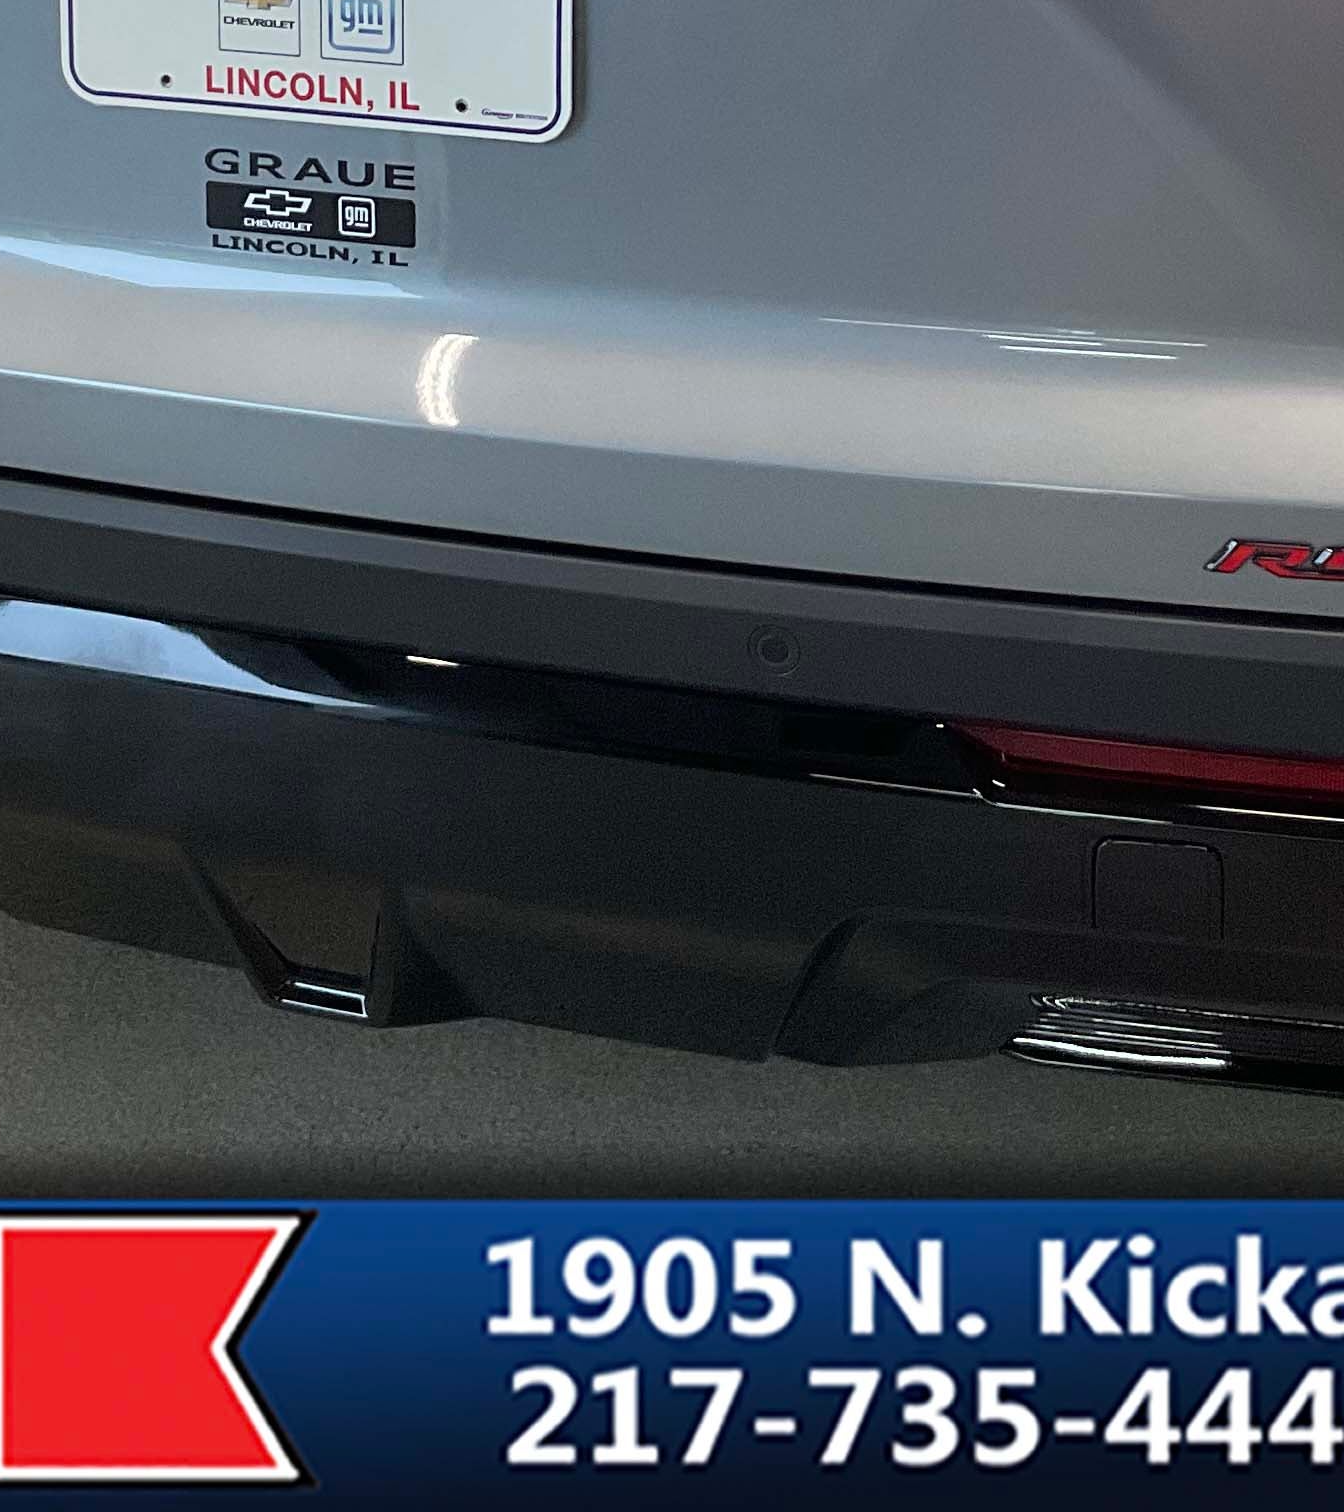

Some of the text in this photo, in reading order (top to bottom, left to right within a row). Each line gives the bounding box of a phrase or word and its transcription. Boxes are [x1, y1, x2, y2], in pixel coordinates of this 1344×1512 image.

[223, 15, 296, 31] CHEVROLET
[205, 65, 420, 112] LINCOLN, IL
[205, 148, 415, 190] GRAUE
[243, 217, 313, 232] CHEVROLET
[344, 205, 369, 228] gm
[212, 234, 408, 267] LINCOLN, IL
